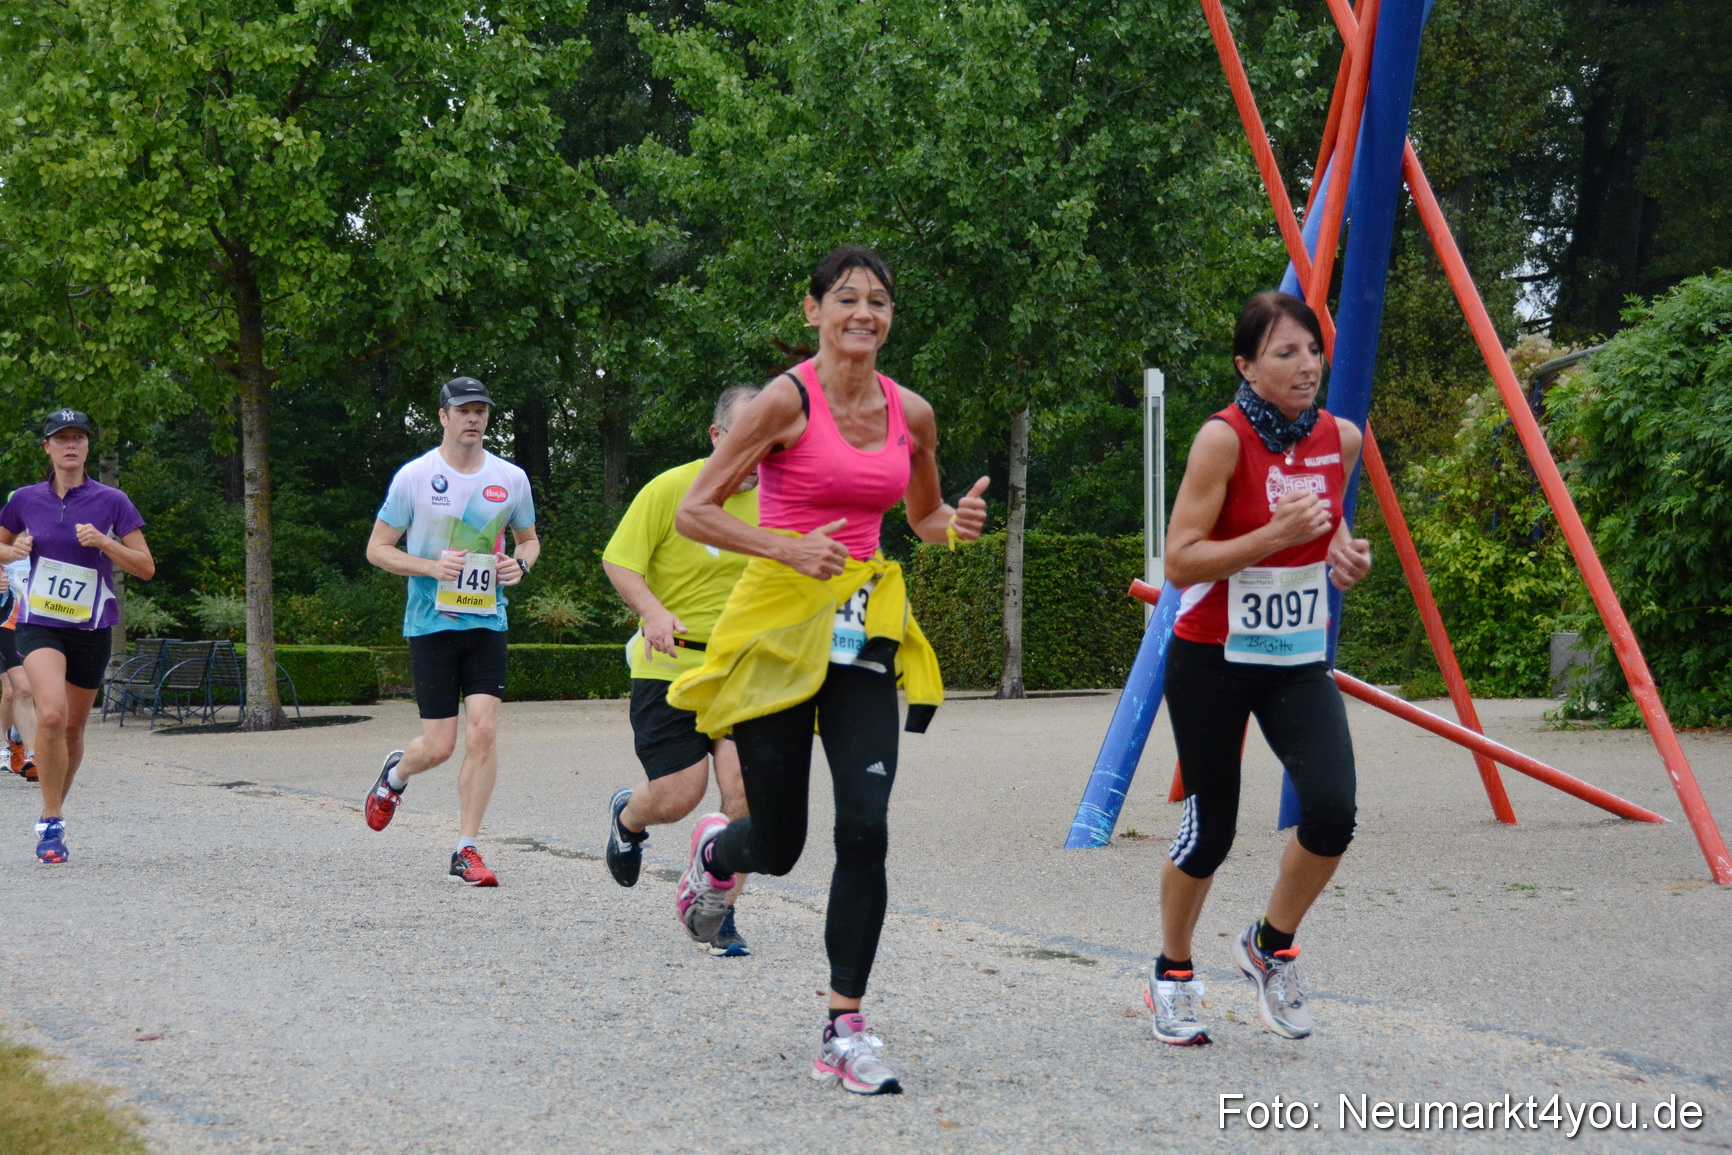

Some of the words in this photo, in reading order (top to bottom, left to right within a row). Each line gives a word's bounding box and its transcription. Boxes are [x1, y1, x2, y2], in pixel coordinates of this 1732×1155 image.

[48, 575, 87, 601] 167
[457, 568, 490, 592] 149
[44, 600, 75, 615] Kathrin
[456, 595, 483, 606] Adrian
[1241, 588, 1319, 630] 3097
[1245, 636, 1294, 653] Brigitte
